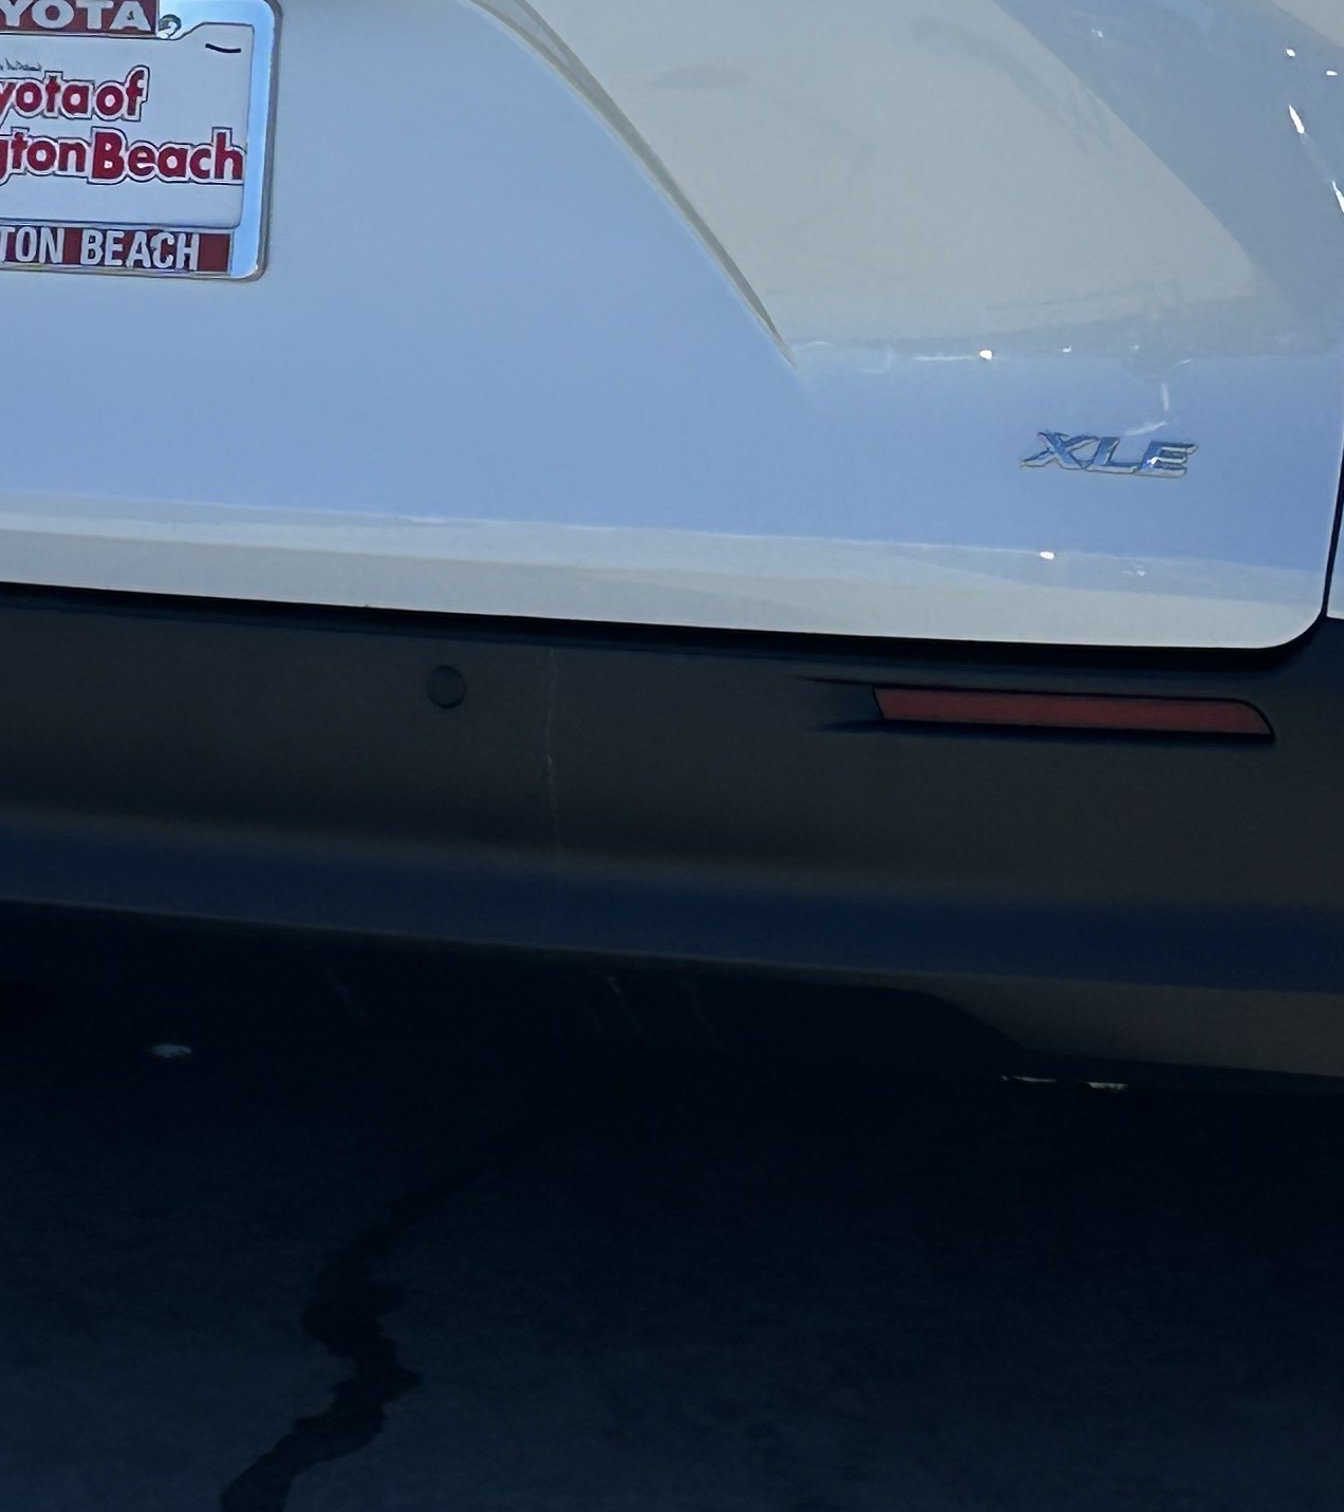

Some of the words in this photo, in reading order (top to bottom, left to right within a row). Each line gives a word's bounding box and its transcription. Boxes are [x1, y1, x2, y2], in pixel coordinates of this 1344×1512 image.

[94, 66, 150, 120] of
[89, 129, 244, 184] Beach
[80, 228, 199, 272] BEACH
[1020, 430, 1198, 478] XLE
